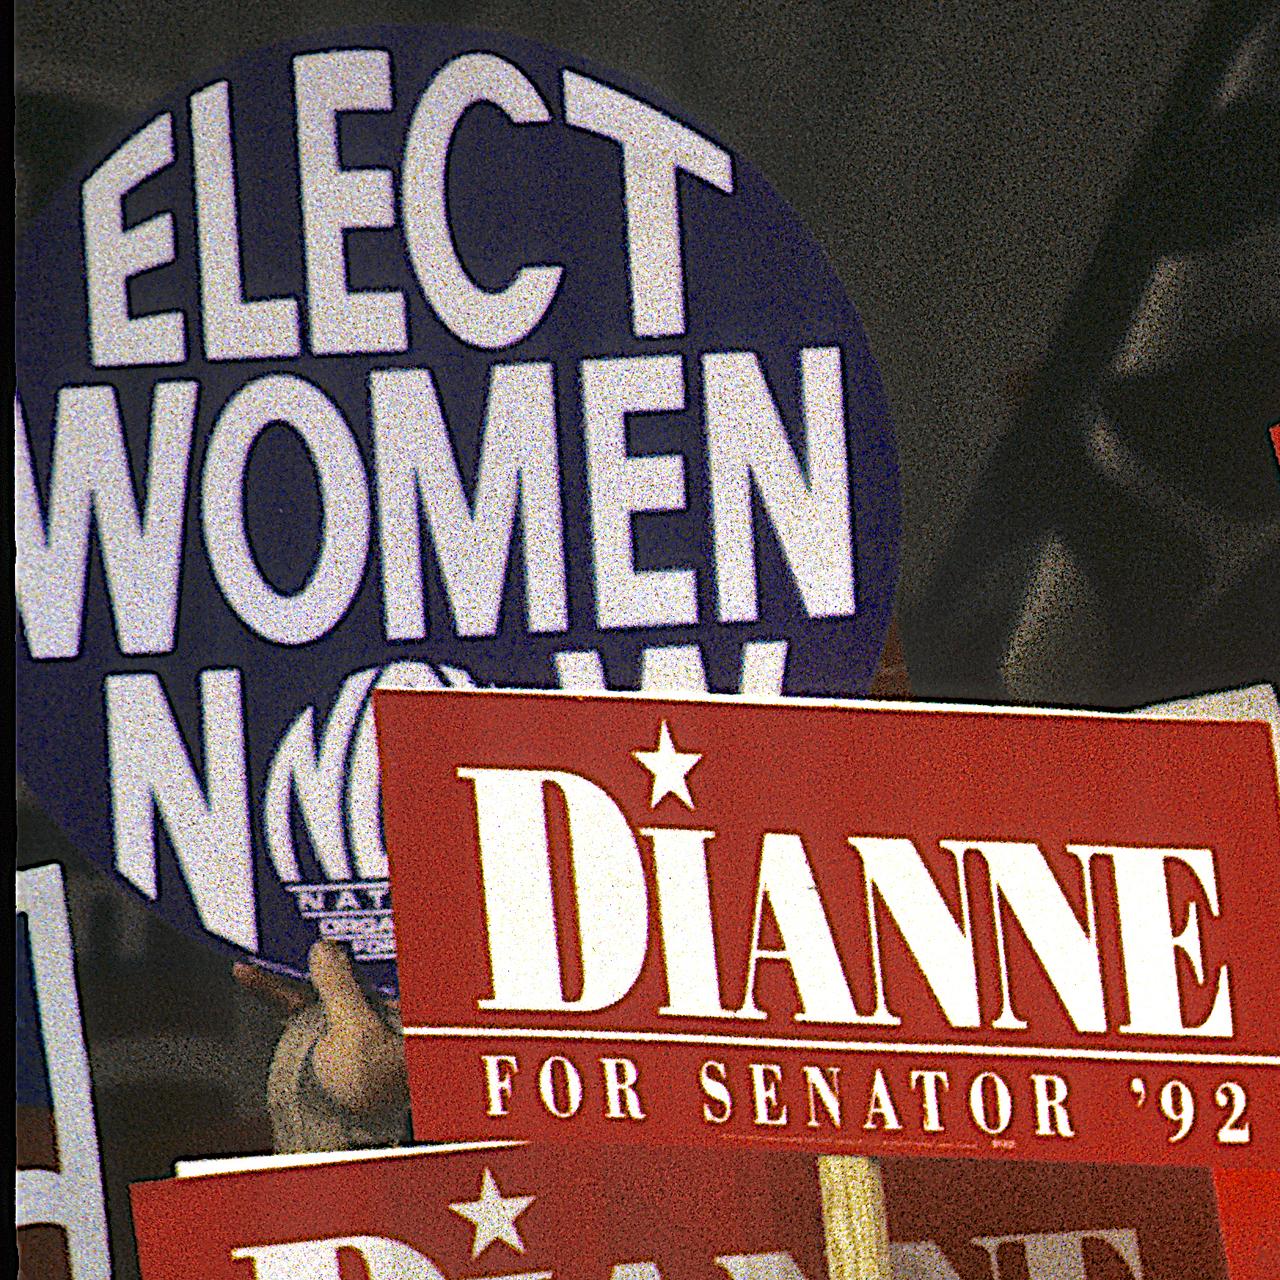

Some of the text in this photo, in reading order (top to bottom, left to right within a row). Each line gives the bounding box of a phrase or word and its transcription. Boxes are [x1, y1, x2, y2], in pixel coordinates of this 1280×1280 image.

[80, 47, 735, 368] ELECT
[14, 346, 857, 661] WOMEN
[456, 765, 1234, 1039] DIANNE
[484, 1055, 1252, 1144] FOR SENATOR '92
